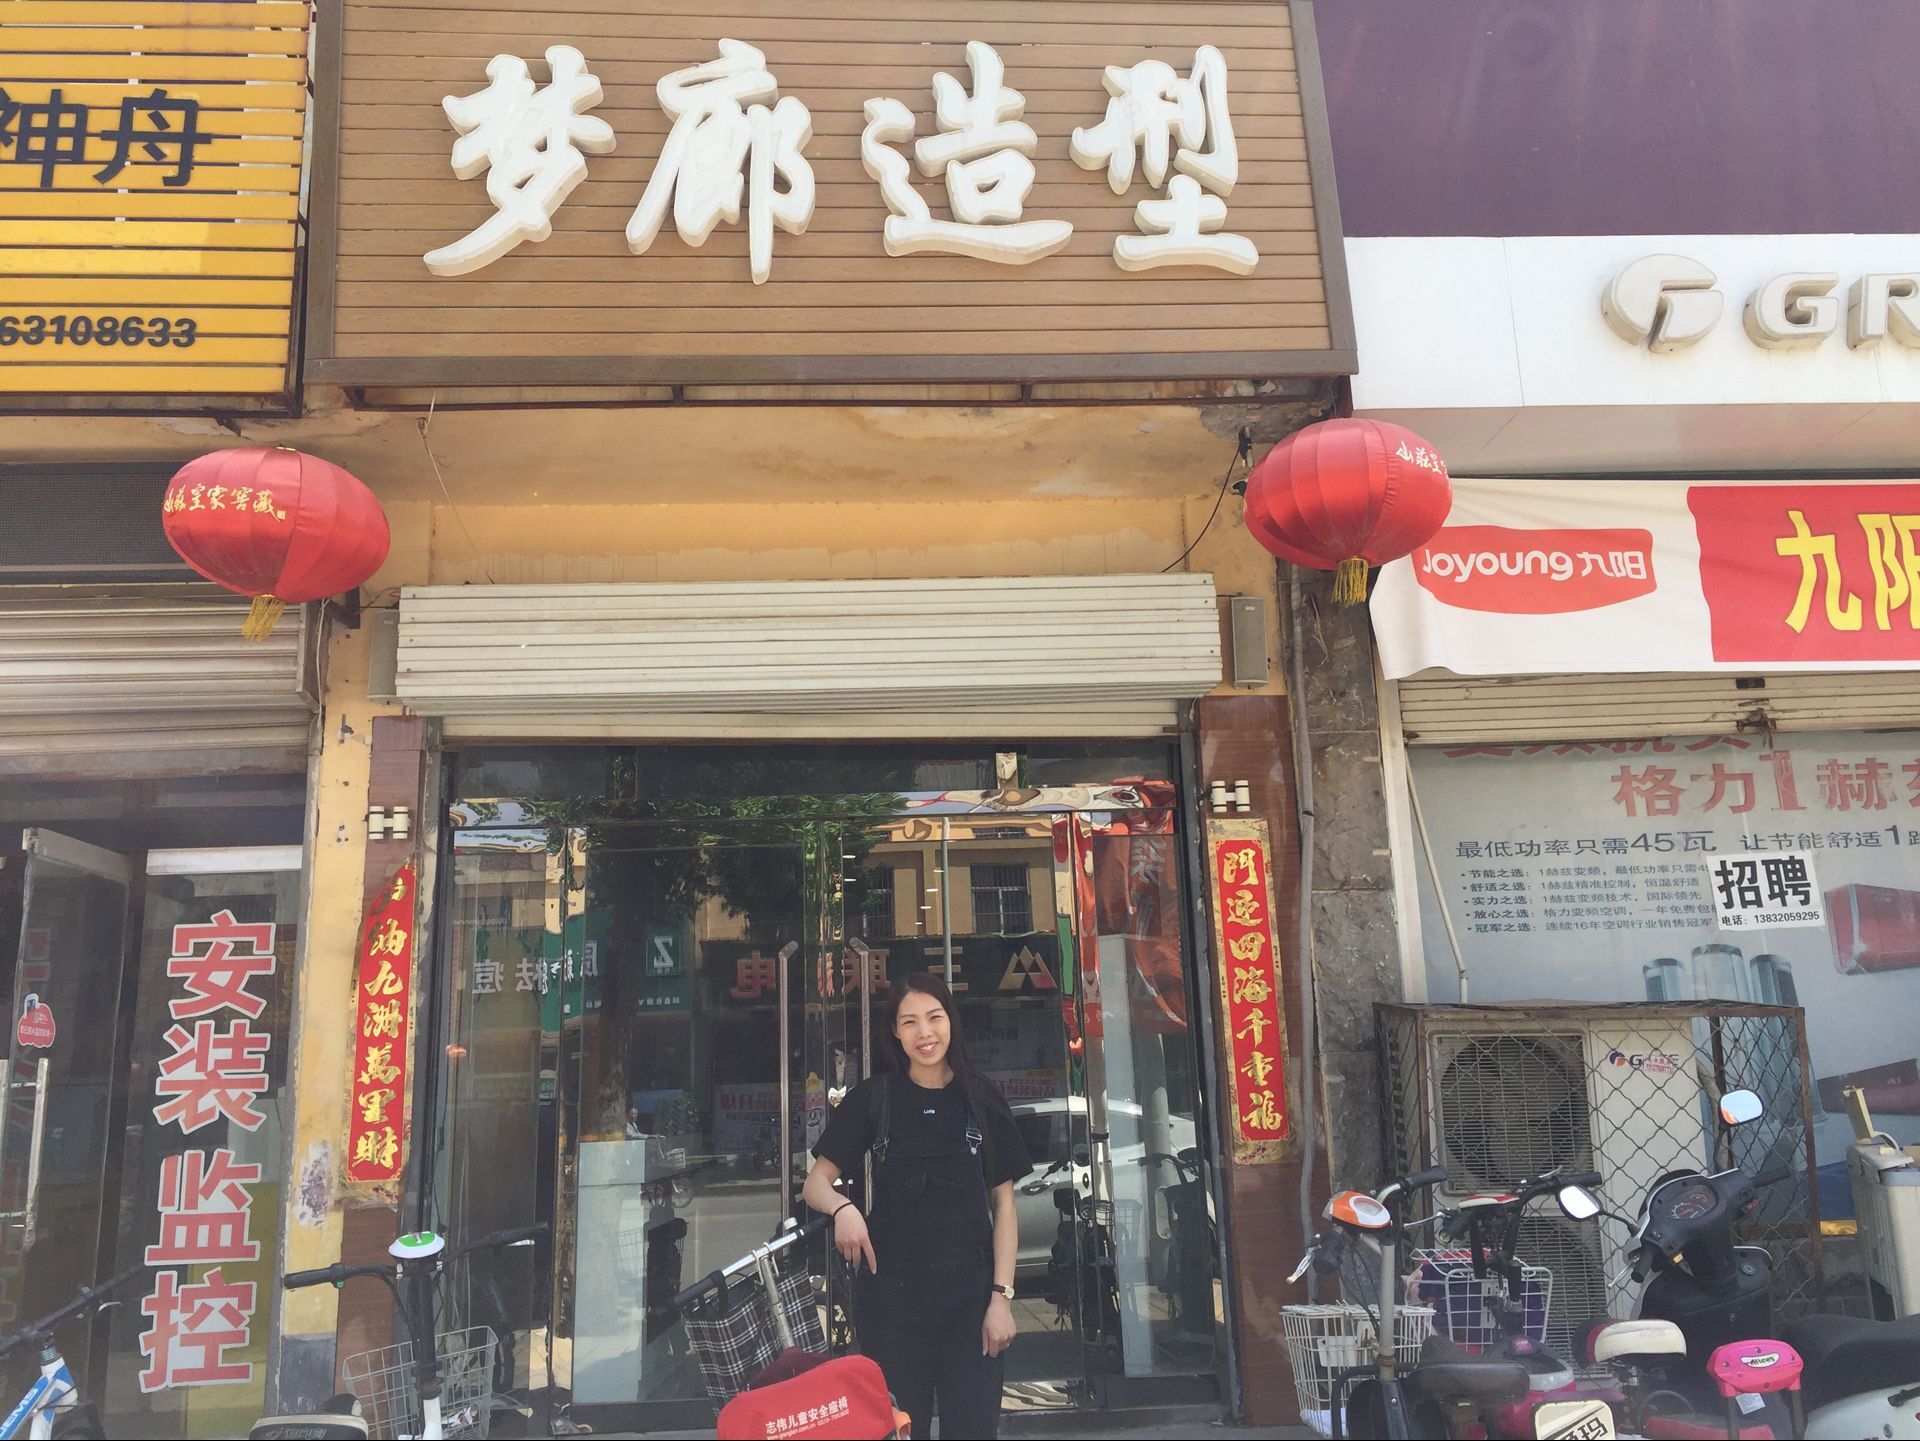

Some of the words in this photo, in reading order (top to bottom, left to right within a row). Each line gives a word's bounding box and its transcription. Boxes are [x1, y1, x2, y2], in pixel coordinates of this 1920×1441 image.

[423, 38, 1260, 285] 梦廊造型
[0, 314, 197, 348] 63108633
[1422, 549, 1574, 583] Joyoung
[1577, 551, 1648, 580] 九阳
[1455, 830, 1717, 859] 最低功率只需45瓦
[1714, 855, 1812, 910] 招聘
[765, 1395, 849, 1435] 志伟儿童安全座椅
